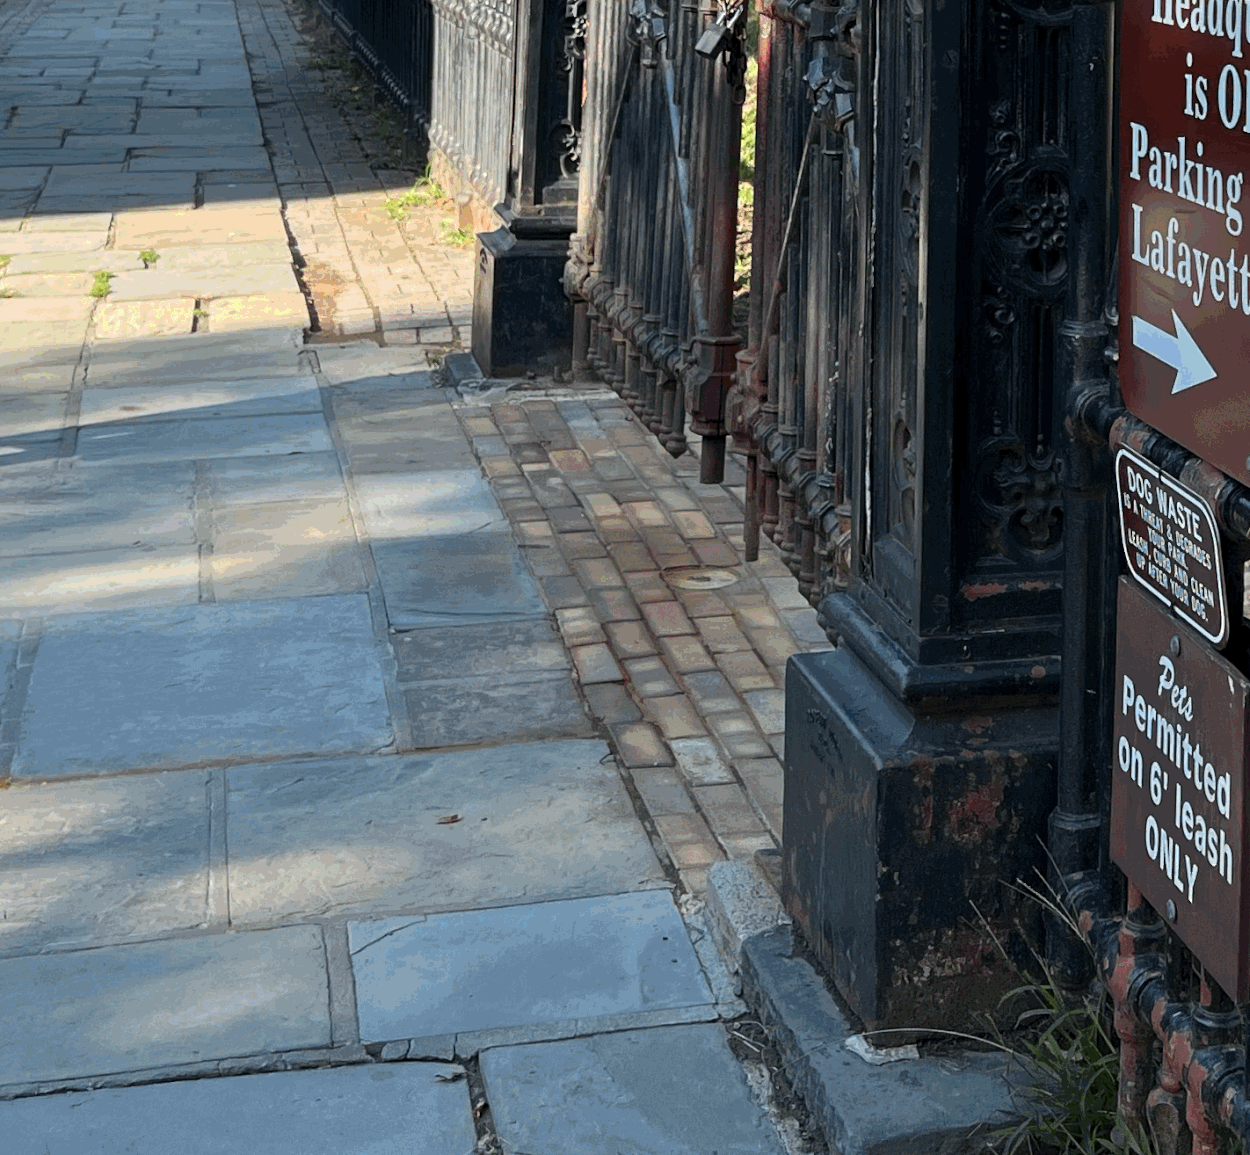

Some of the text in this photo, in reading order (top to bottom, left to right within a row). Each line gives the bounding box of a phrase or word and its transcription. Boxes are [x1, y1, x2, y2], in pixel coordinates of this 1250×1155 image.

[1183, 52, 1208, 122] is
[1129, 122, 1243, 236] Parking
[1127, 465, 1203, 543] DOG WASTE
[1133, 499, 1139, 515] A
[1139, 503, 1164, 535] THREAT
[1166, 524, 1174, 542] &
[1175, 530, 1212, 571] DEGRADES
[1146, 525, 1167, 553] YOUR
[1135, 551, 1146, 571] UP
[1148, 561, 1169, 590] AFTER
[1169, 578, 1190, 607] YOUR
[1152, 547, 1172, 574] CURB
[1173, 563, 1189, 587] AND
[1190, 576, 1215, 608] CLEAN
[1157, 655, 1194, 722] Pets
[1122, 674, 1231, 820] Permitted
[1118, 735, 1233, 885] on 6' leash
[1145, 814, 1199, 904] ONLY
